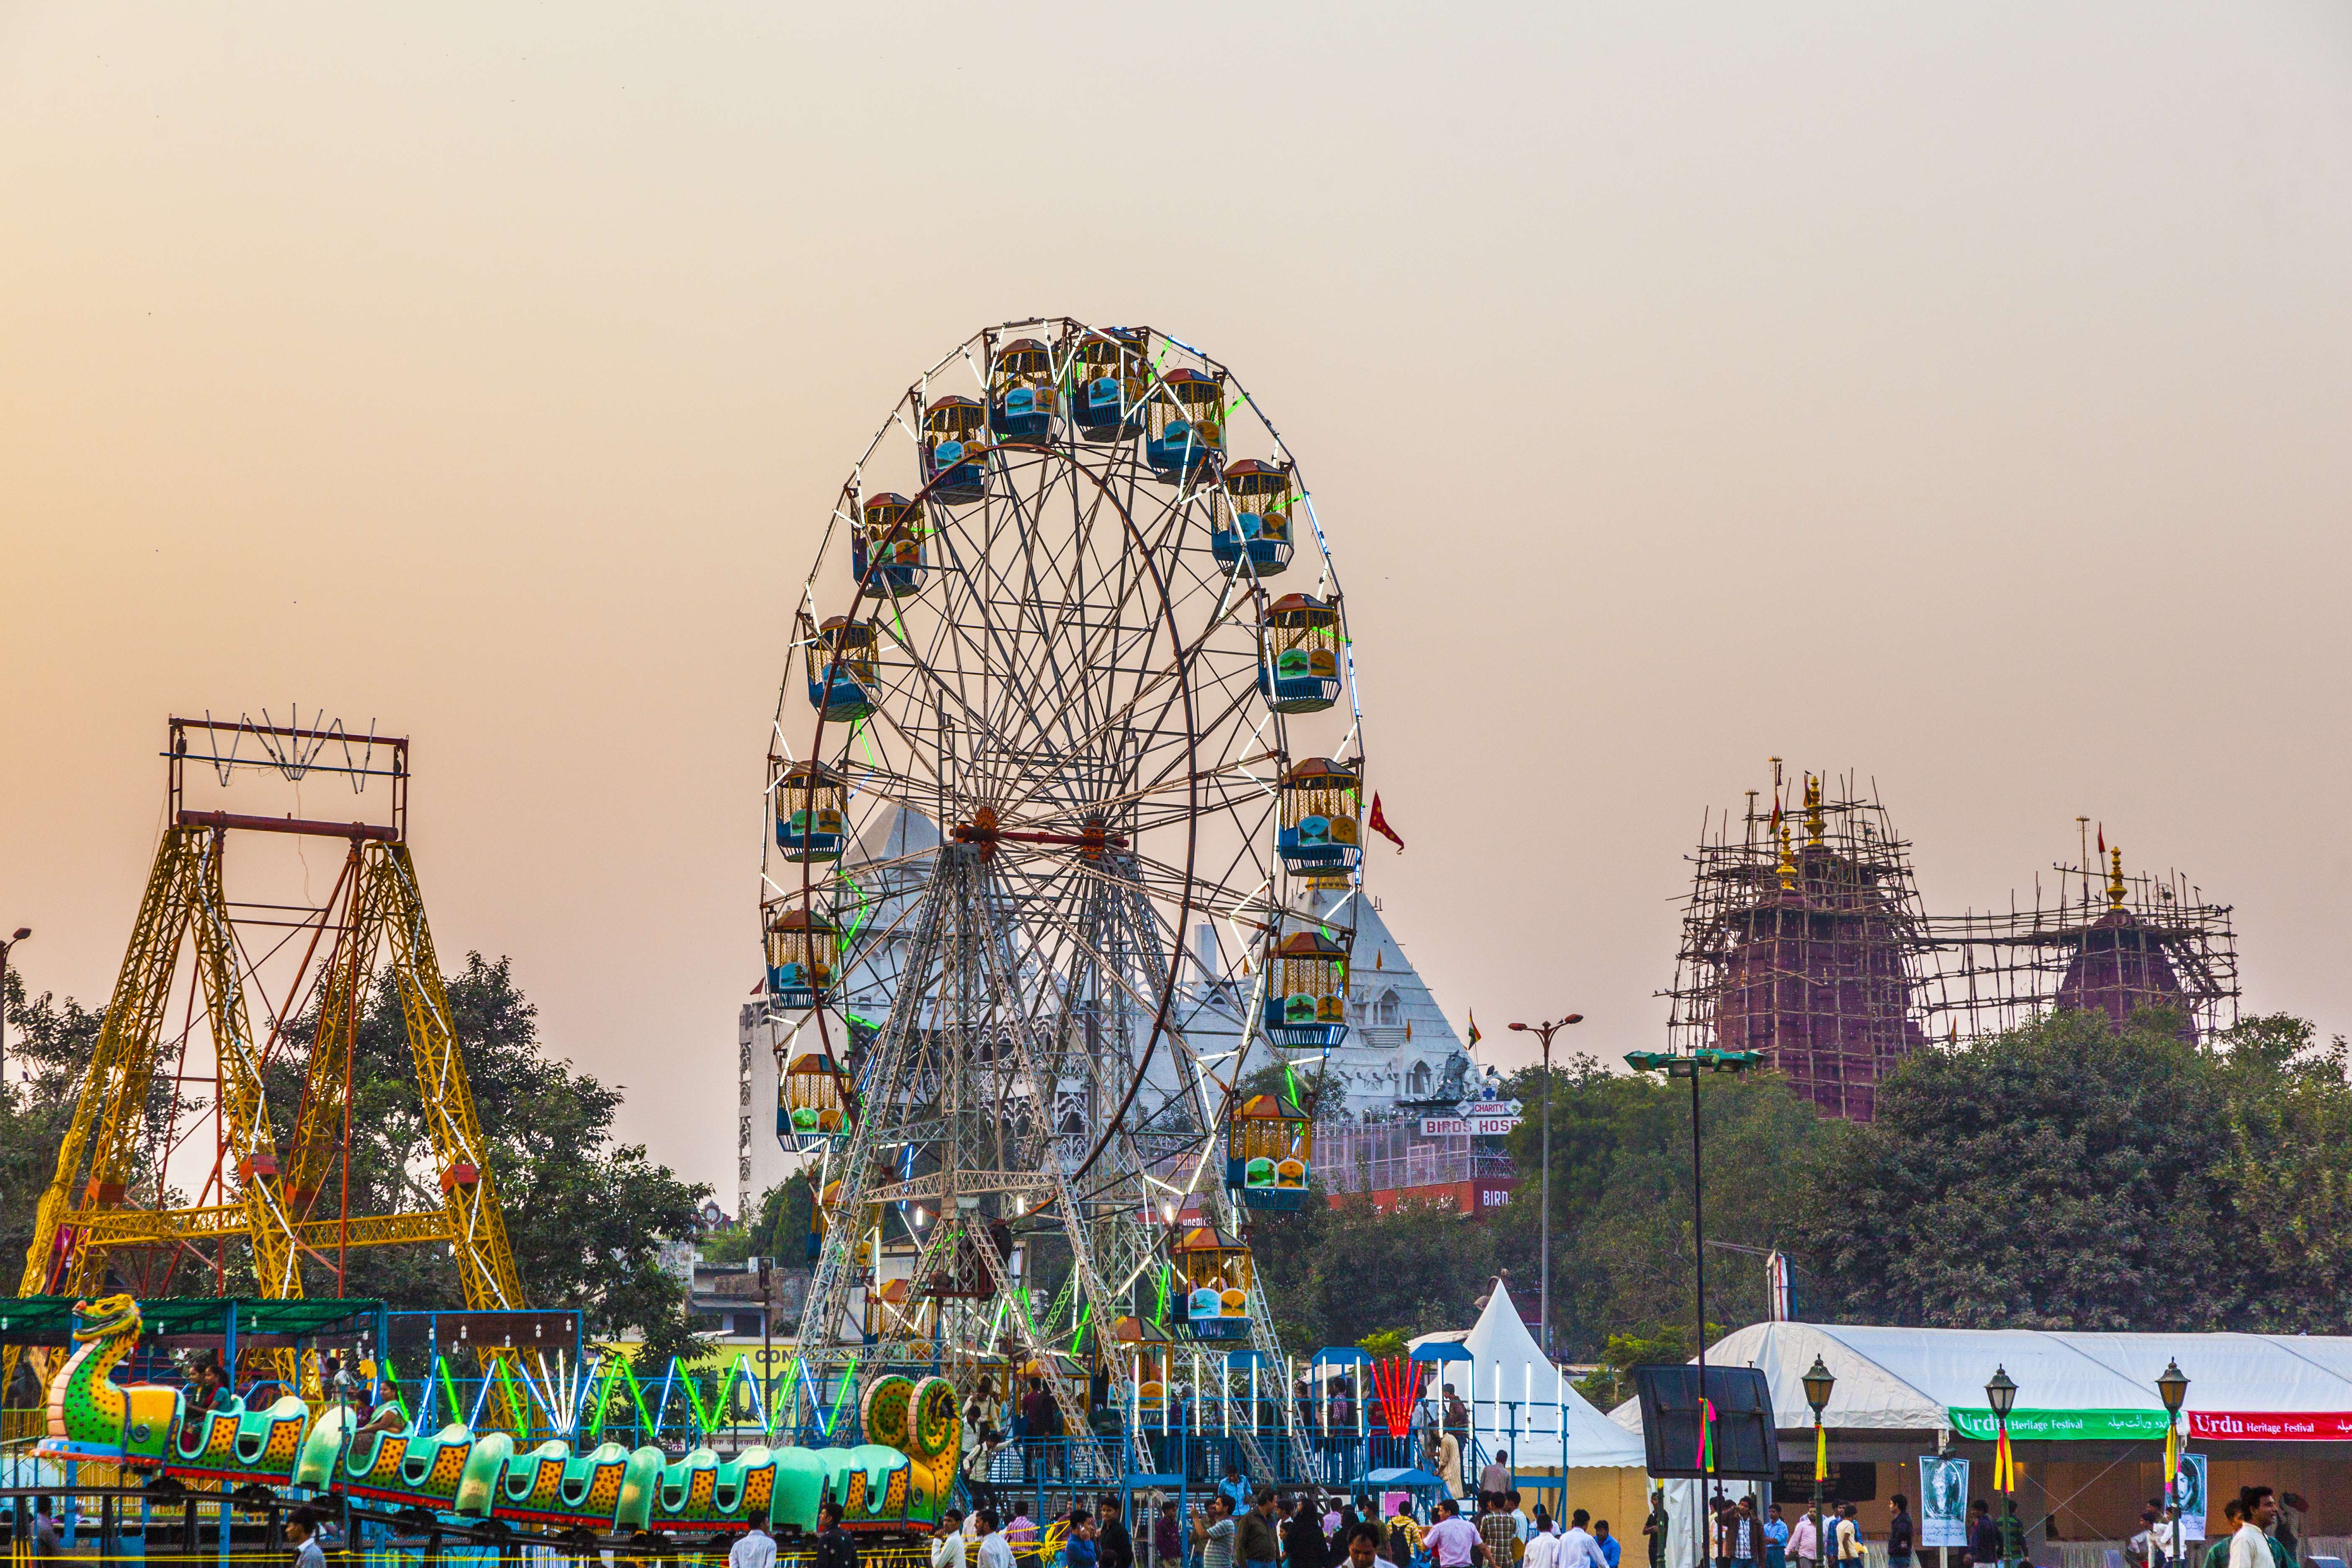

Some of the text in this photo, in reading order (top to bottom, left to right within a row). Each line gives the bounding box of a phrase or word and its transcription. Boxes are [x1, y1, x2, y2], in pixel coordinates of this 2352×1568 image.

[1475, 1104, 1504, 1112] CHARITY
[1426, 1120, 1519, 1133] BIRDS HOSP
[1483, 1190, 1512, 1206] BIRD
[2011, 1420, 2048, 1432] Heritage
[2052, 1419, 2083, 1429] Festival
[2195, 1414, 2314, 1434] Urdu Heritage Festival
